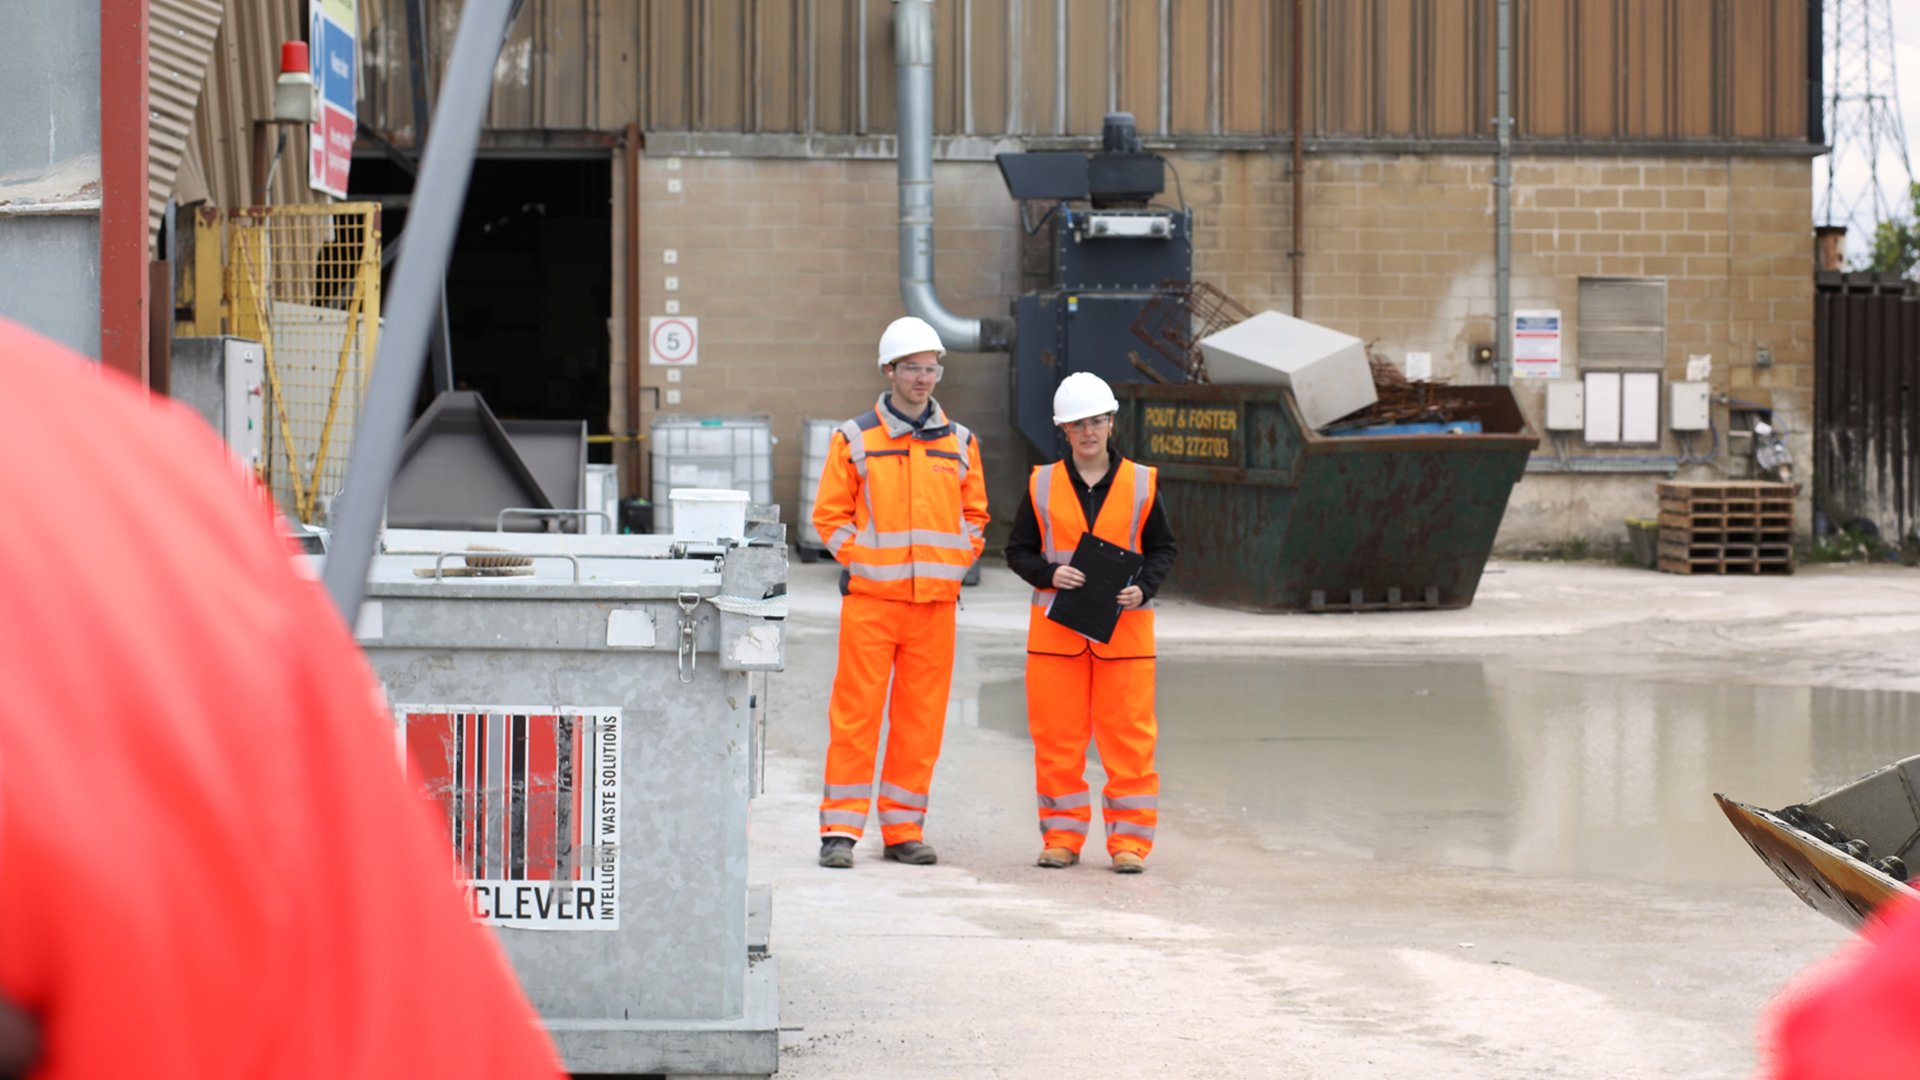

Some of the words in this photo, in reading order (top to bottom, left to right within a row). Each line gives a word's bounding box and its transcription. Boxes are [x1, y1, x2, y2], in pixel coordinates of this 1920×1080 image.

[667, 332, 680, 351] 5
[1145, 408, 1176, 428] POUT
[1189, 409, 1237, 430] FOSTER
[1185, 436, 1229, 458] 272703
[603, 715, 617, 786] SOLUTIONS
[602, 791, 616, 835] WASTE
[601, 840, 615, 920] INTELLIGENT
